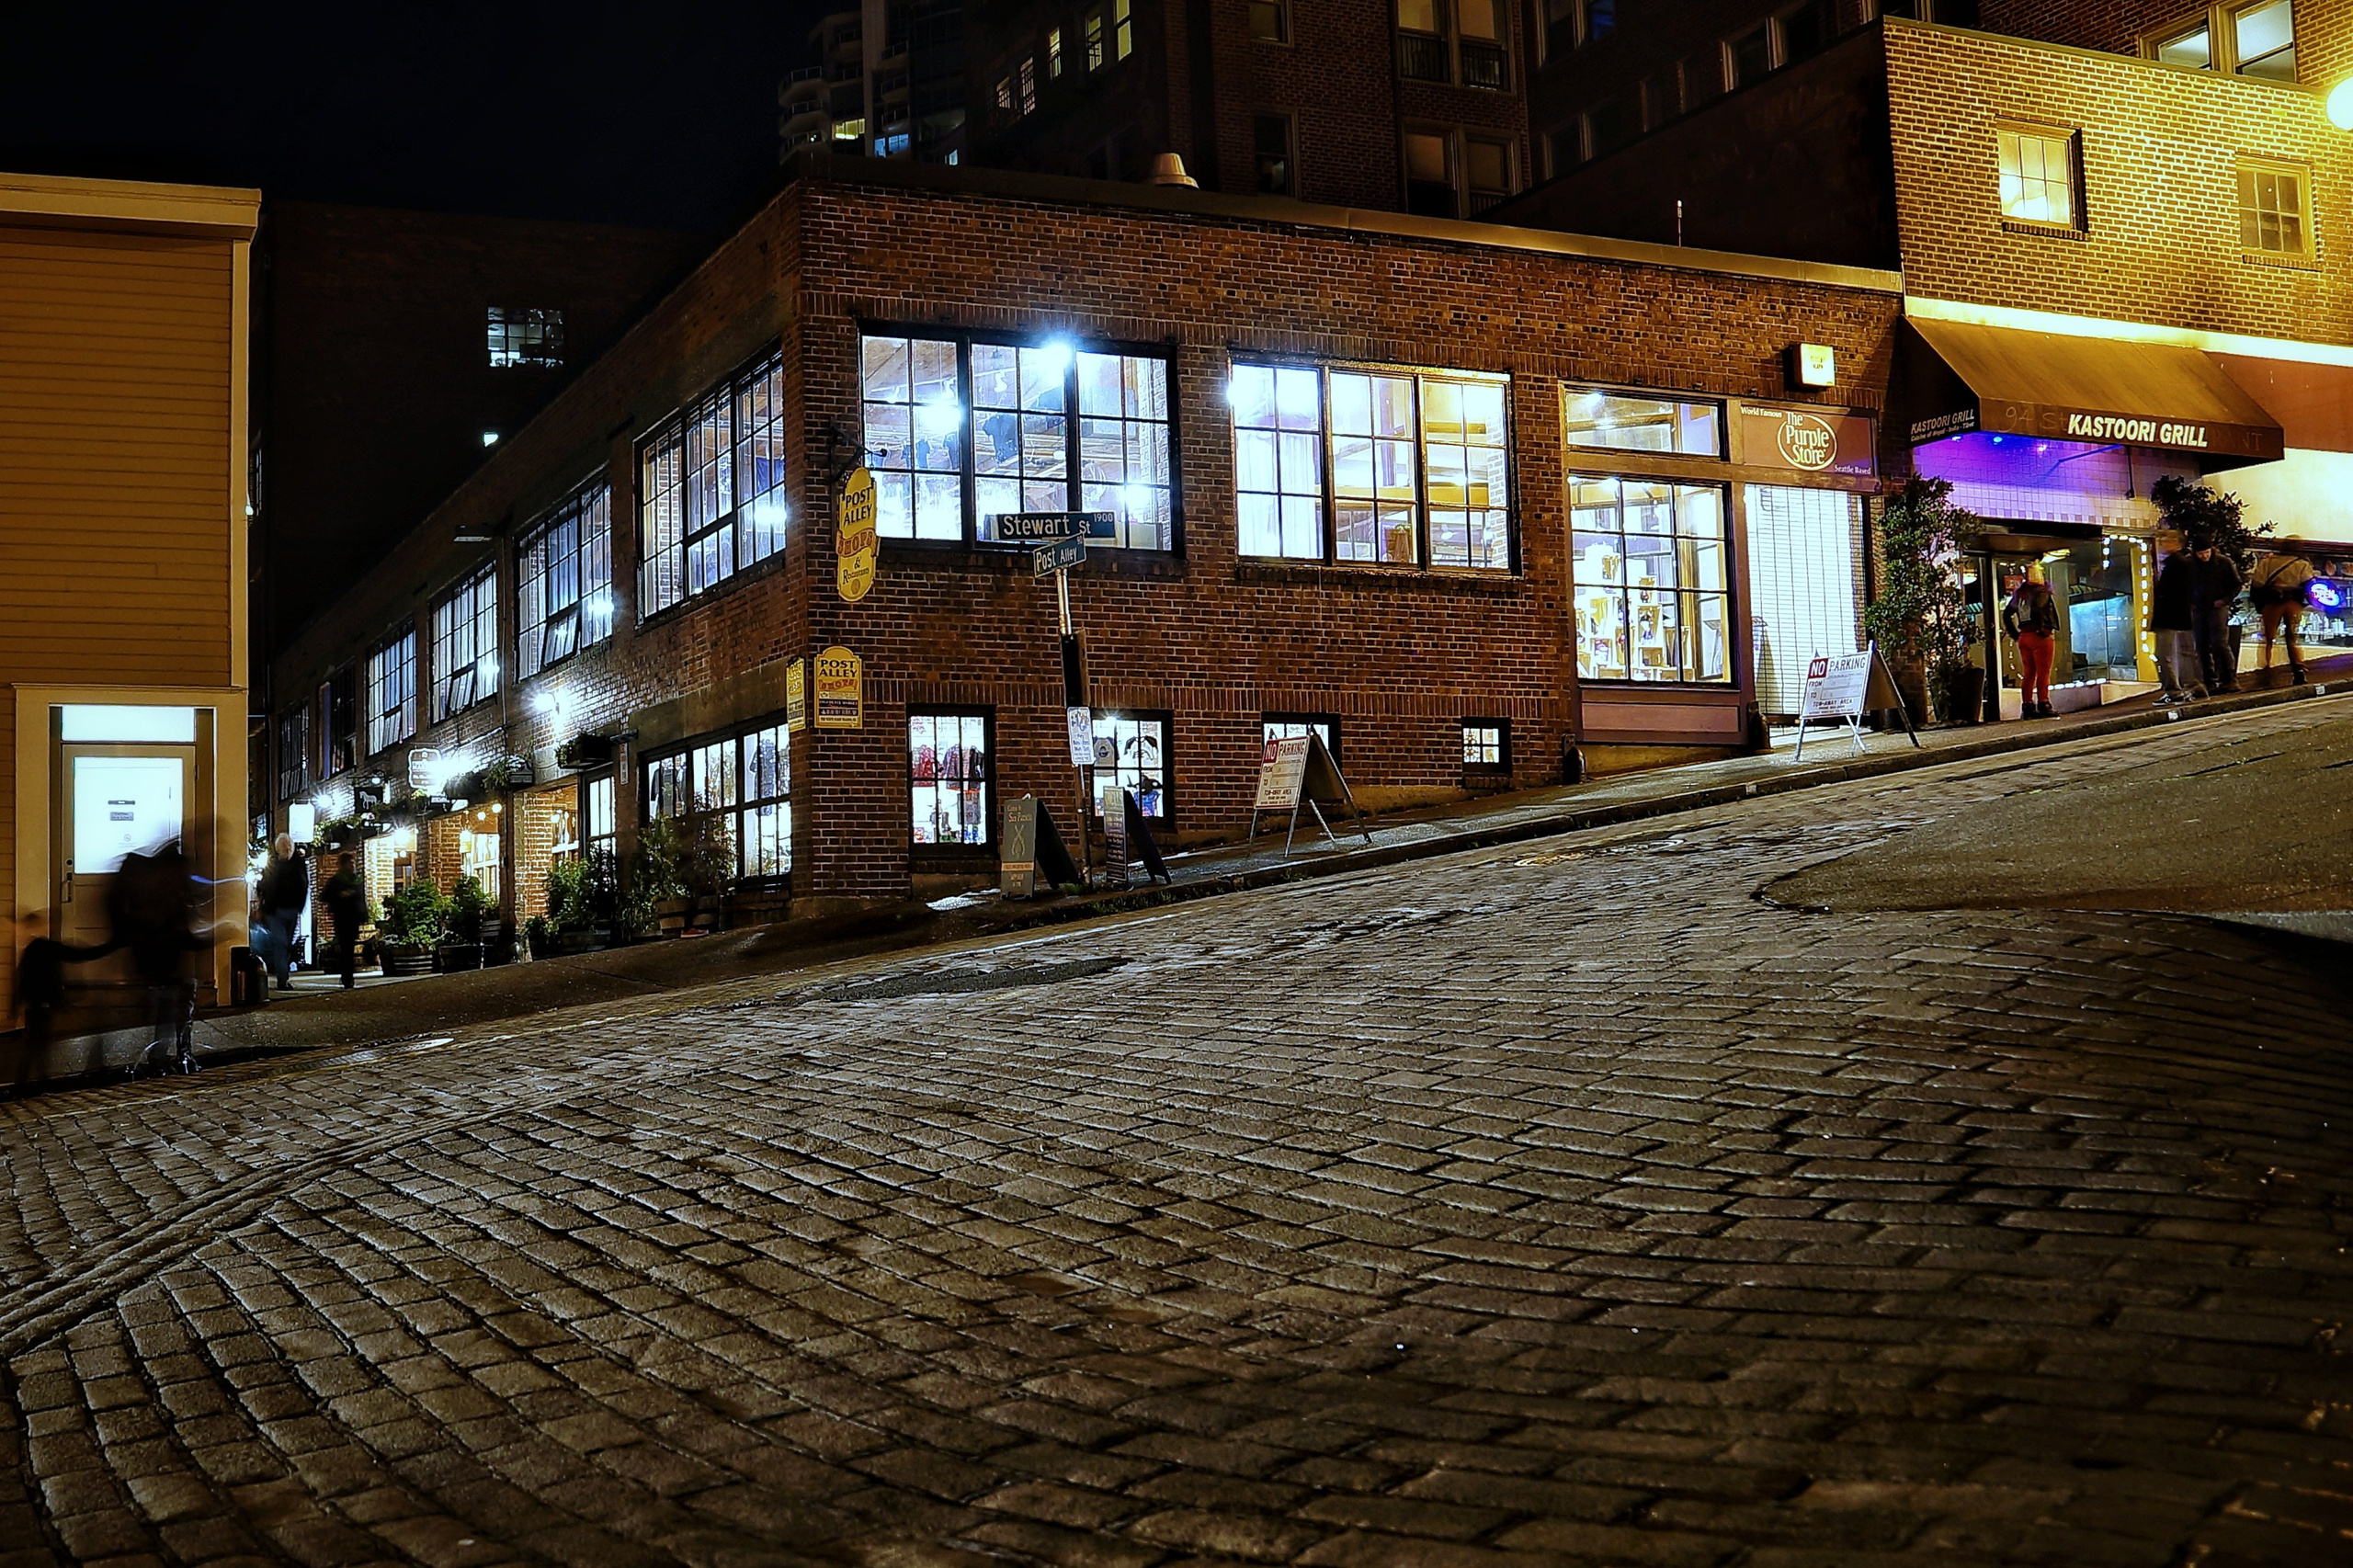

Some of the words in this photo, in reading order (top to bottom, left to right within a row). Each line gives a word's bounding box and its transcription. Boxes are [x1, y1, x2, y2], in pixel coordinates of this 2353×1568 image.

[1741, 406, 1759, 416] World
[1760, 408, 1782, 418] Famous
[1786, 411, 1803, 426] The
[1910, 414, 1950, 436] KASTOORI
[1951, 408, 1975, 425] GRILL
[1785, 425, 1830, 449] Purple
[2068, 414, 2156, 442] KASTOORI
[2159, 423, 2209, 448] GRILL
[1792, 444, 1825, 464] Store
[1835, 464, 1854, 474] Seattle
[1855, 466, 1871, 475] Based
[845, 486, 872, 509] POST
[842, 503, 873, 528] ALLEY
[1003, 515, 1071, 536] Stewart
[1078, 520, 1092, 534] St
[1093, 513, 1114, 523] 1900
[837, 530, 874, 555] SHOPS
[1035, 547, 1057, 573] Post
[1060, 547, 1078, 564] Alley
[819, 668, 858, 677] ALLEY
[820, 659, 856, 669] POST
[1811, 661, 1825, 676] NO
[1829, 657, 1865, 672] PARKING
[1265, 744, 1277, 760] NO
[1279, 742, 1305, 756] PARKING
